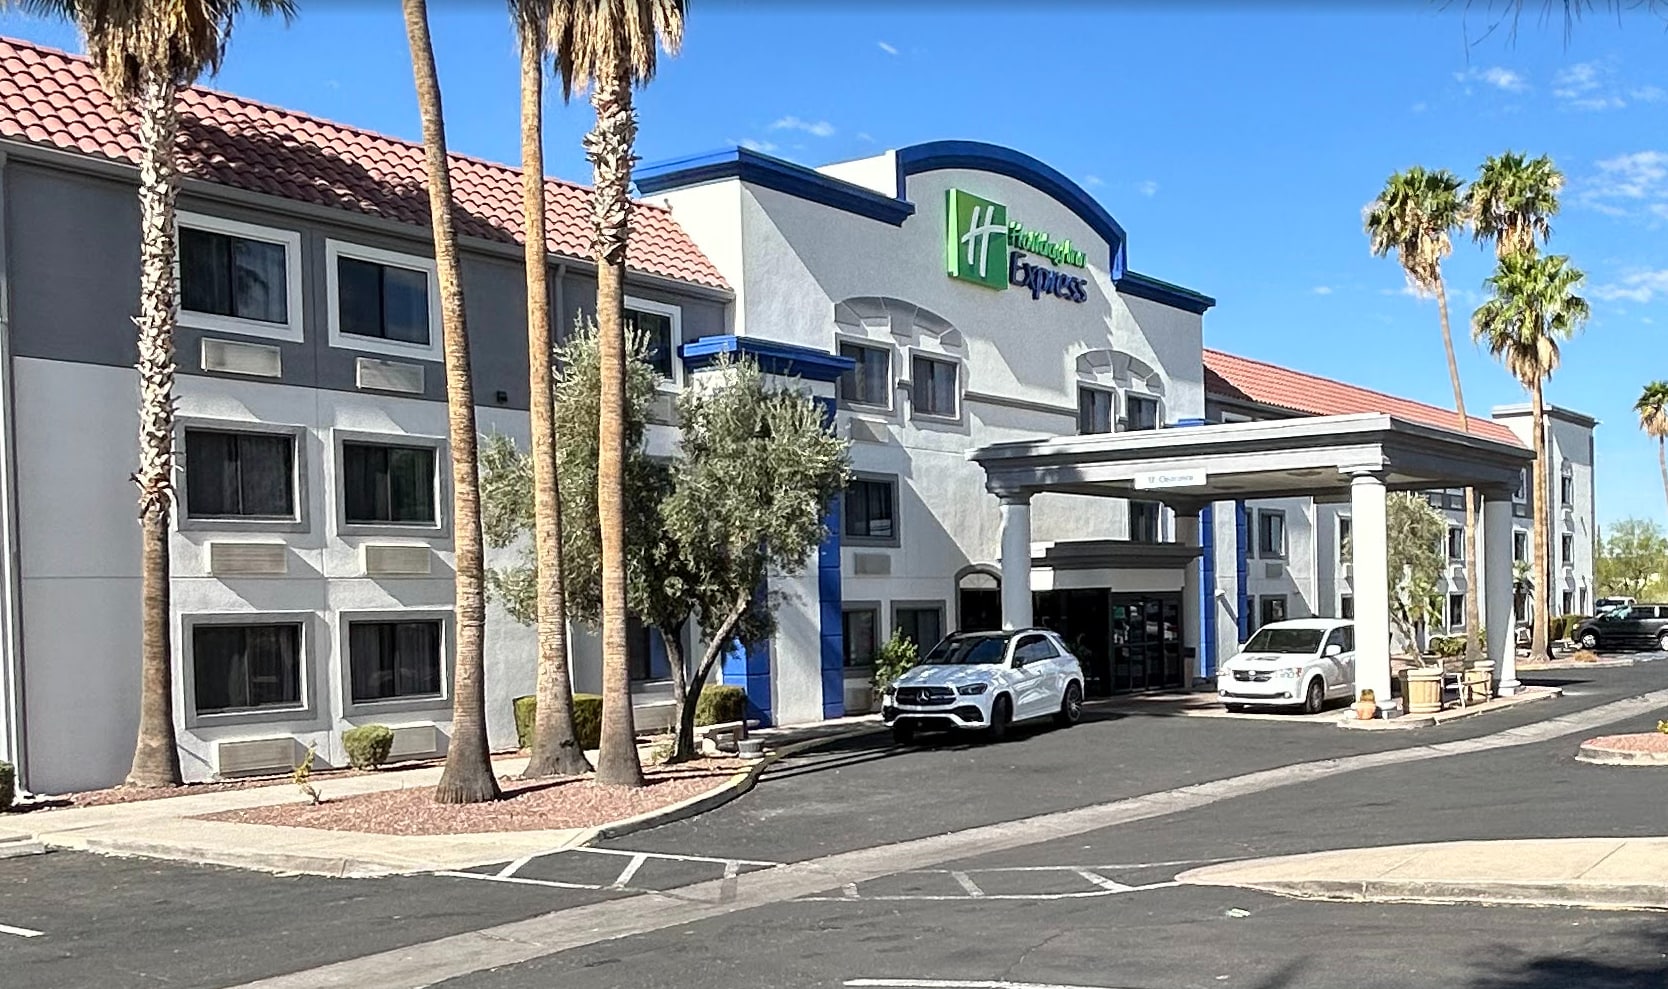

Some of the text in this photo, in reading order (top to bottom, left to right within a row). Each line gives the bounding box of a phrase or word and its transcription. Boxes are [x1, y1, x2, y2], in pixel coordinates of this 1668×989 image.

[1008, 221, 1087, 268] Holiday Inn
[1009, 251, 1088, 303] Express
